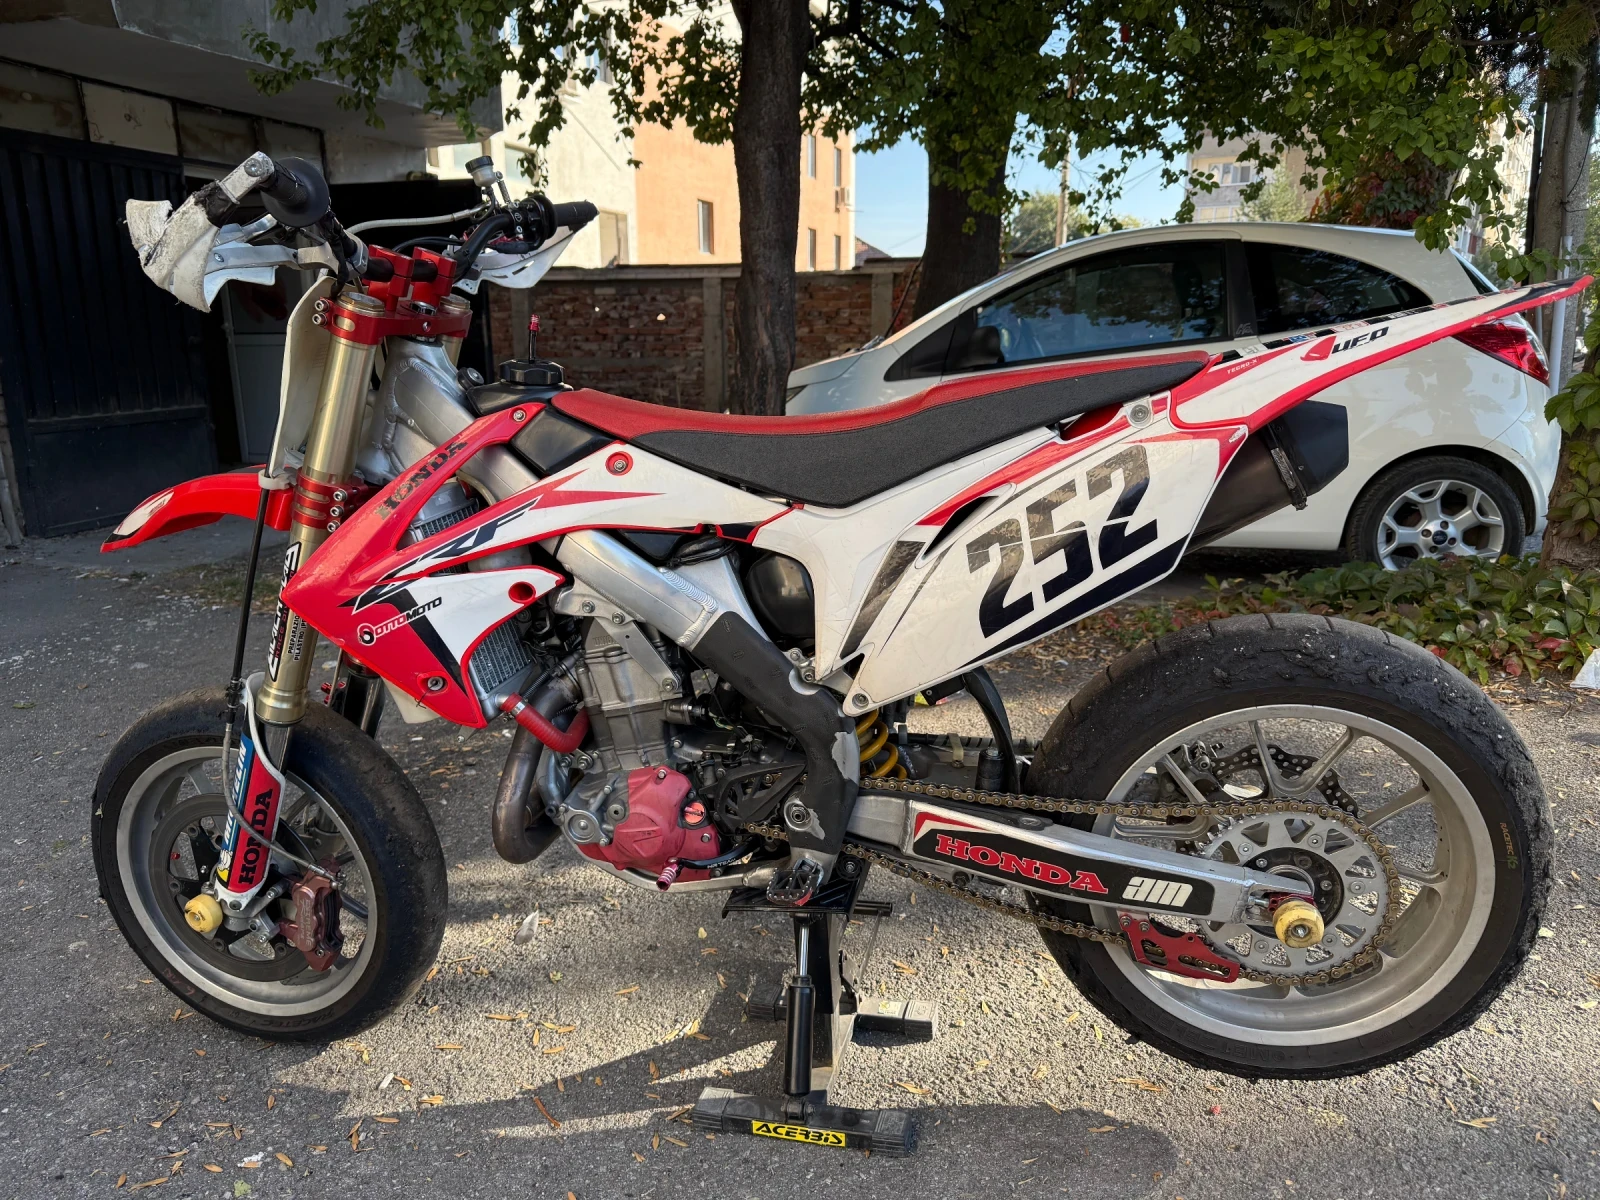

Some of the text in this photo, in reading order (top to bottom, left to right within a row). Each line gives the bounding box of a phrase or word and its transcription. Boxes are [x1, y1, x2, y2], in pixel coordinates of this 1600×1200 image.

[1332, 326, 1389, 354] UFO
[966, 444, 1158, 639] 252
[287, 615, 301, 655] PREPARAZIO
[238, 788, 273, 885] HONDA
[1500, 822, 1515, 856] RACETEC
[935, 833, 1109, 895] HONDA
